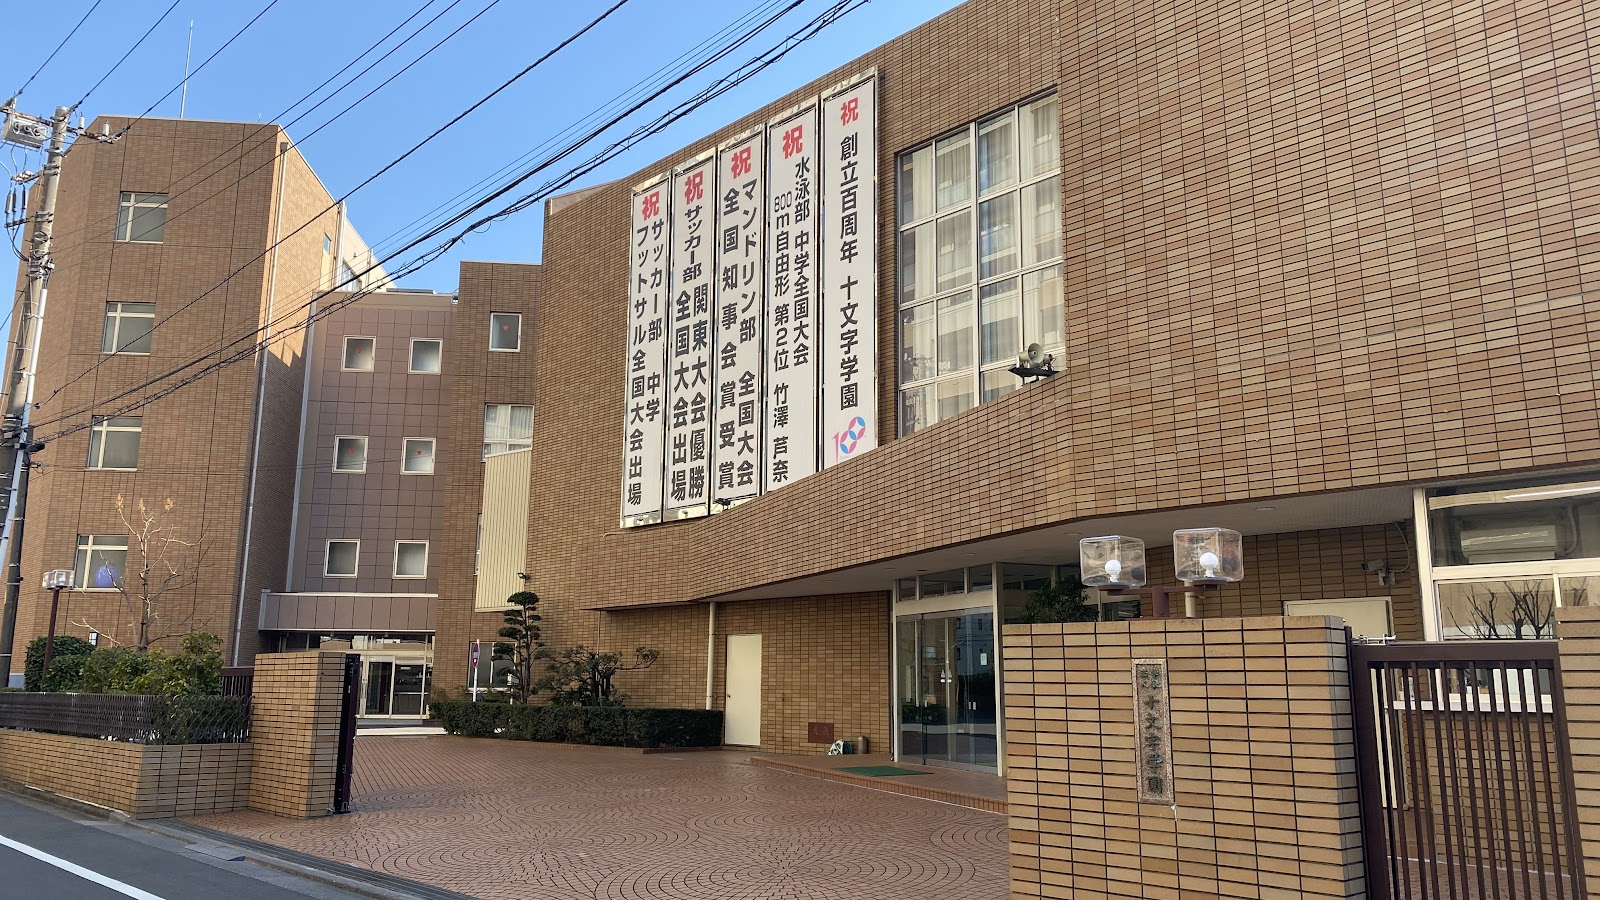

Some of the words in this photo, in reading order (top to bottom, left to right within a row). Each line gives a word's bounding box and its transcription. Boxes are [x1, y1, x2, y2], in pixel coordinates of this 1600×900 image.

[782, 124, 803, 160] 祝
[840, 97, 859, 127] 祝
[684, 170, 704, 205] 祝
[731, 146, 752, 179] 祝
[794, 156, 810, 225] 水泳部
[840, 131, 859, 264] 創立百周年
[642, 191, 660, 221] 祝
[682, 204, 703, 284] サッカー部
[648, 218, 665, 342] サッカー部
[739, 178, 758, 344] マンドリン部
[793, 230, 810, 368] 中学全国大会
[627, 225, 649, 506] フットサル全国大会出場
[718, 188, 740, 491] 全国知事会賞受賞
[773, 303, 790, 372] 第2位
[840, 275, 859, 411] 十文字学園
[646, 371, 661, 422] 中学
[670, 290, 691, 502] 全国大会出場
[688, 282, 709, 499] 関東大会優勝
[736, 370, 756, 487] 全国大会
[773, 382, 789, 429] 竹澤
[772, 436, 789, 483] 芦奈
